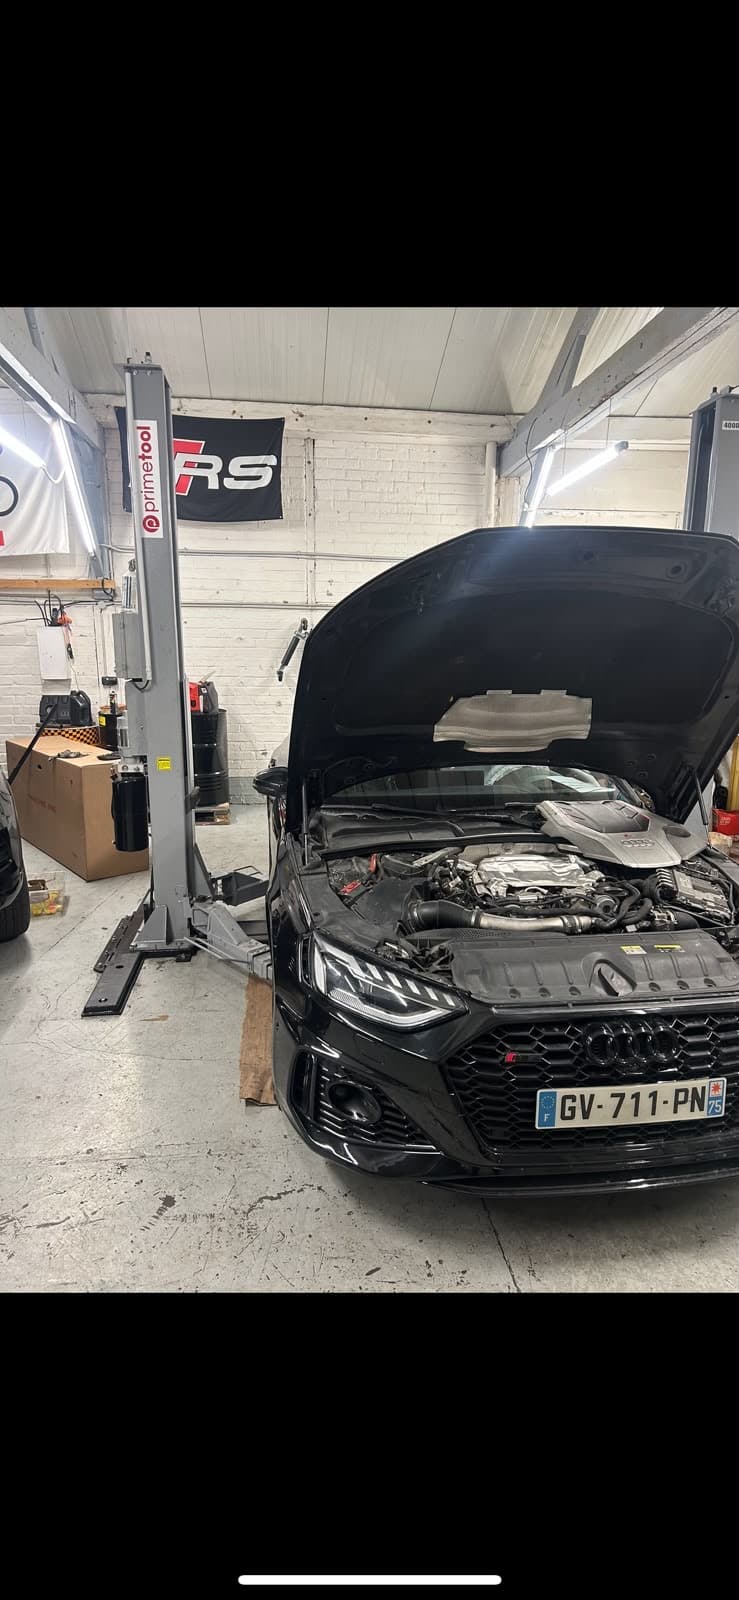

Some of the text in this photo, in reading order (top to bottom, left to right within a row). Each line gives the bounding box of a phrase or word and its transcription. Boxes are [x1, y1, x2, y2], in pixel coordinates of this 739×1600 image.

[136, 426, 159, 512] primetool
[174, 453, 278, 489] RS
[543, 1113, 550, 1122] F
[560, 1086, 706, 1121] GV-711-PN
[708, 1099, 722, 1116] 75
